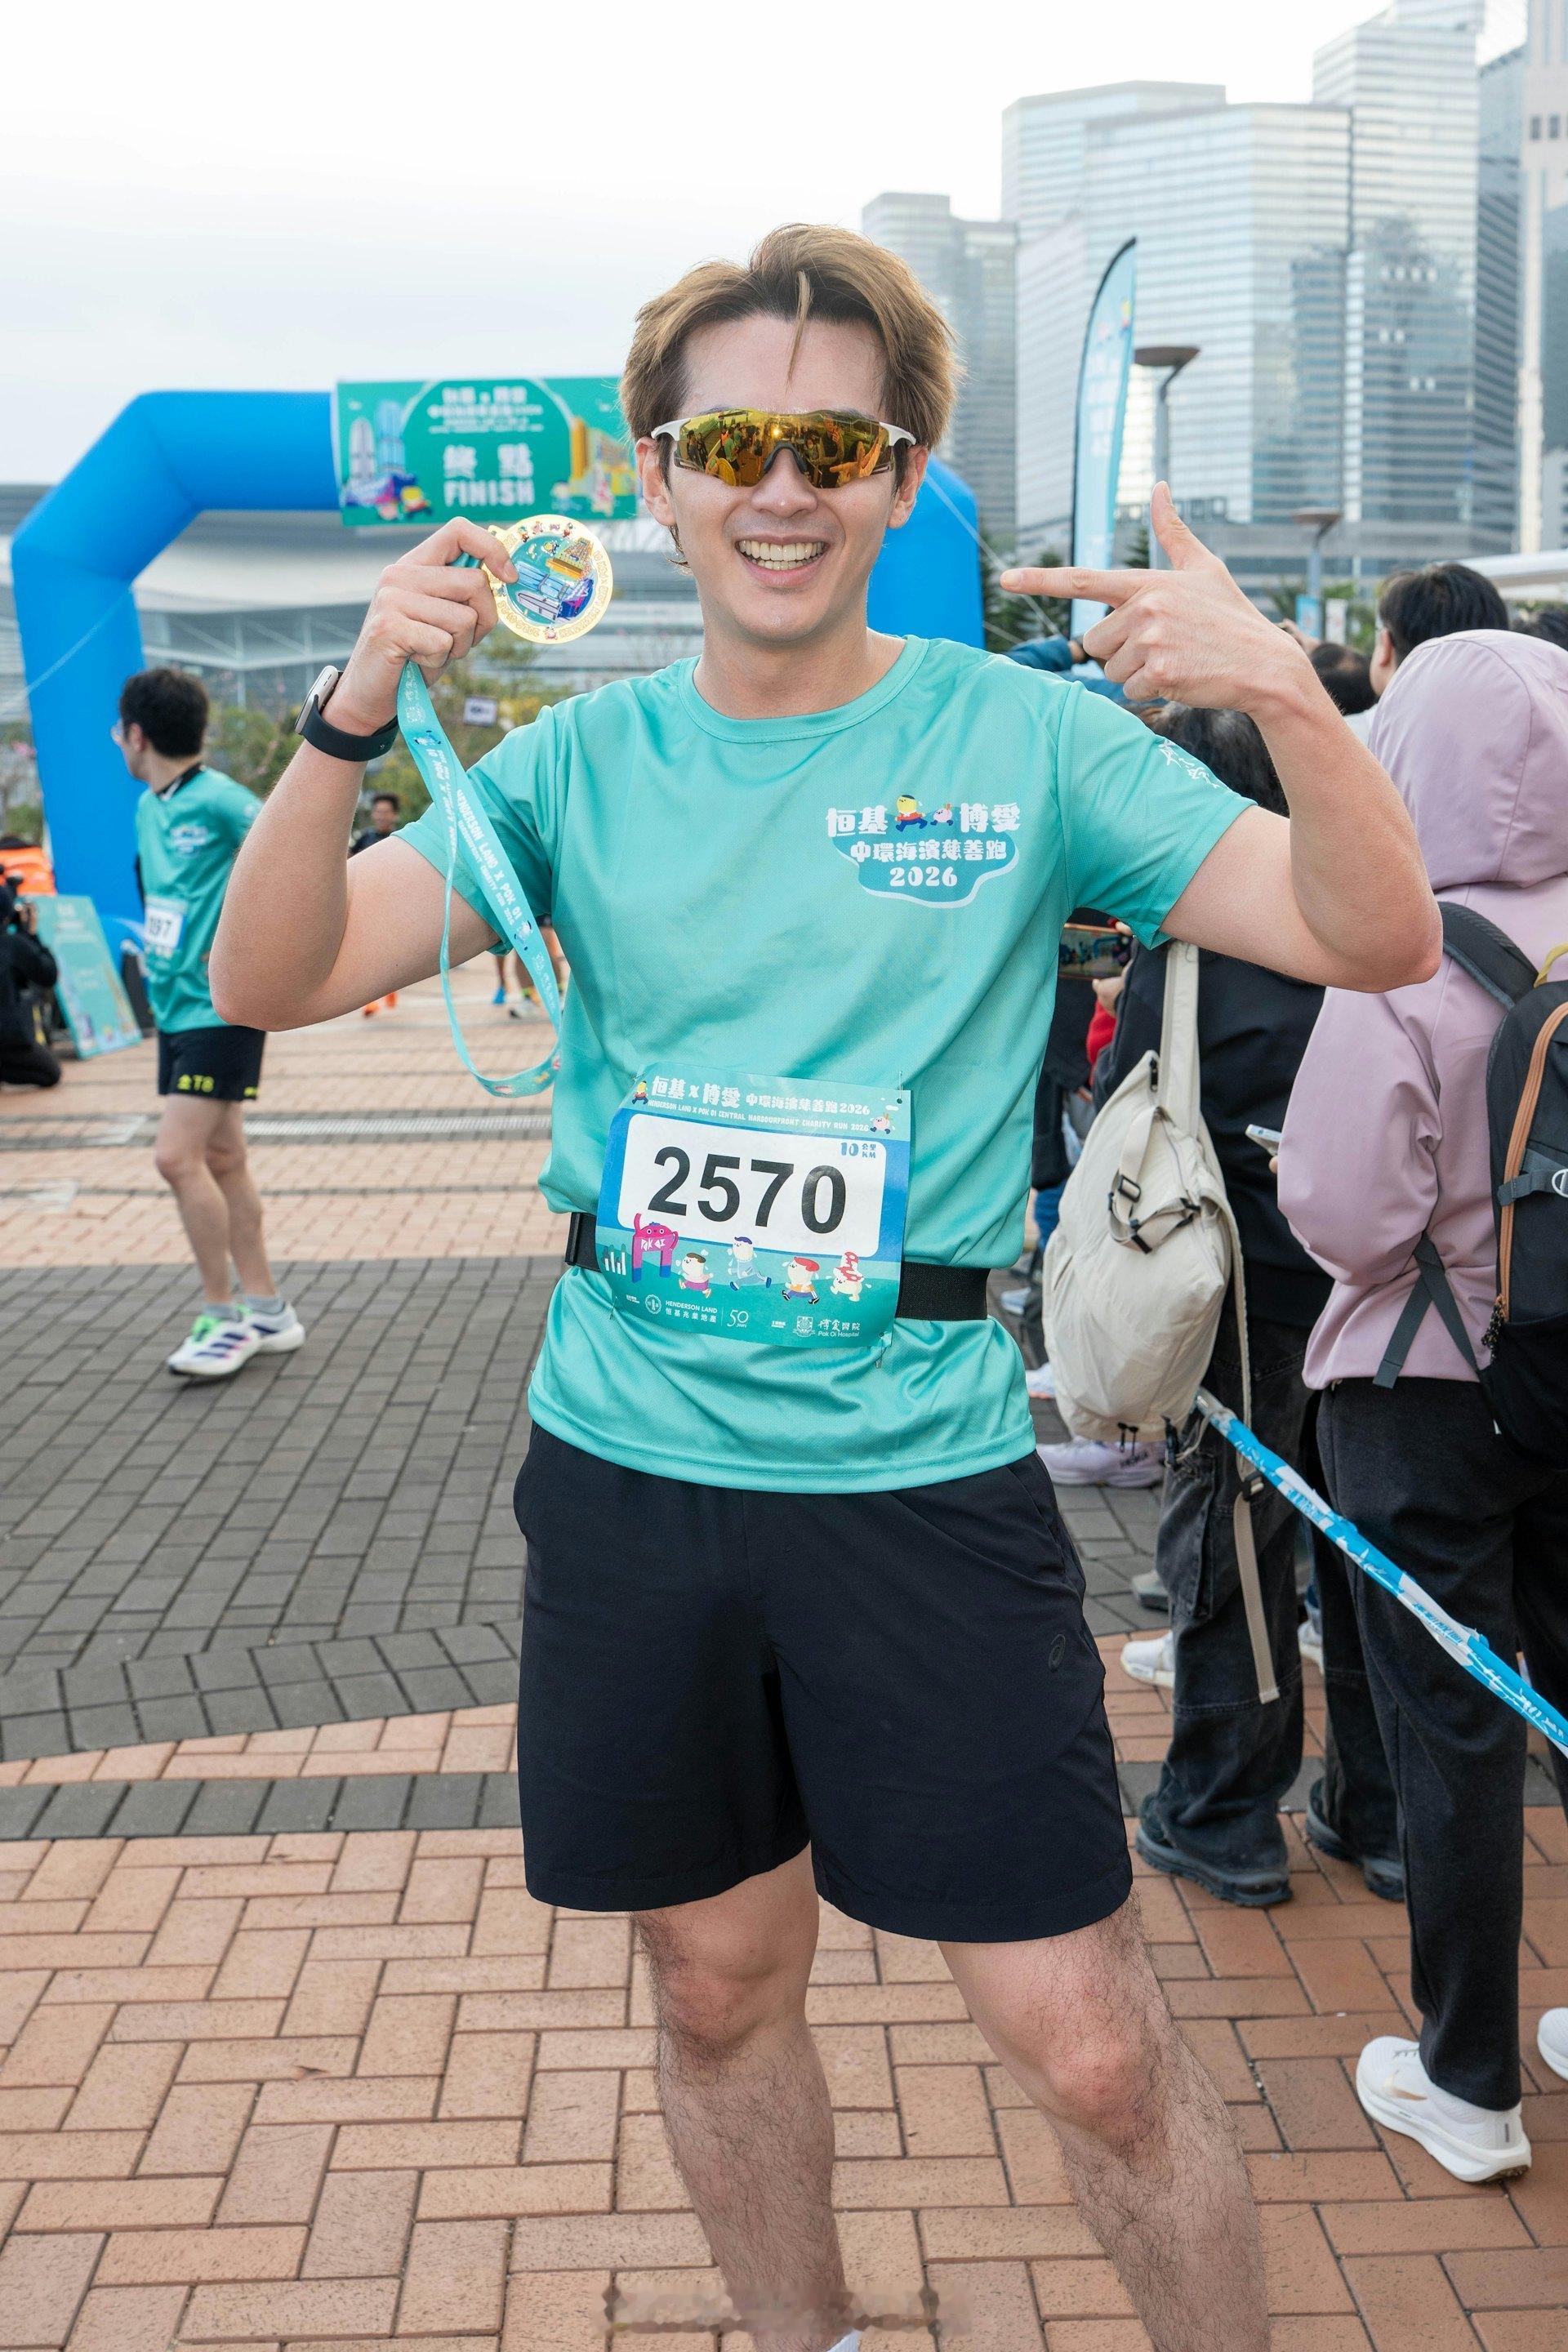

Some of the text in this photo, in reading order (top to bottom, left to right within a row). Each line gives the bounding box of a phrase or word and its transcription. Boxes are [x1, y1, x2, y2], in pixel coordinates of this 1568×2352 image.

[443, 478, 535, 507] FINISH
[826, 802, 1021, 838] 恒基 博愛
[850, 839, 1007, 863] 中環海濱慈善跑
[479, 842, 499, 869] LAND
[500, 882, 516, 906] POK
[889, 866, 958, 887] 2026
[651, 1076, 686, 1100] 恒基
[702, 1082, 741, 1109] 博愛
[648, 1099, 676, 1111] HENDERSON
[678, 1104, 692, 1113] LAND
[698, 1107, 710, 1116] POK
[718, 1110, 746, 1120] CENTRAL
[748, 1114, 800, 1126] HARBOURFRONT
[802, 1119, 831, 1129] CHARITY
[834, 1122, 848, 1130] RUN
[851, 1123, 869, 1132] 2026
[840, 1142, 859, 1156] 10
[647, 1146, 846, 1234] 2570
[665, 1300, 718, 1314] HENDERSON LAND
[727, 1309, 749, 1327] 50
